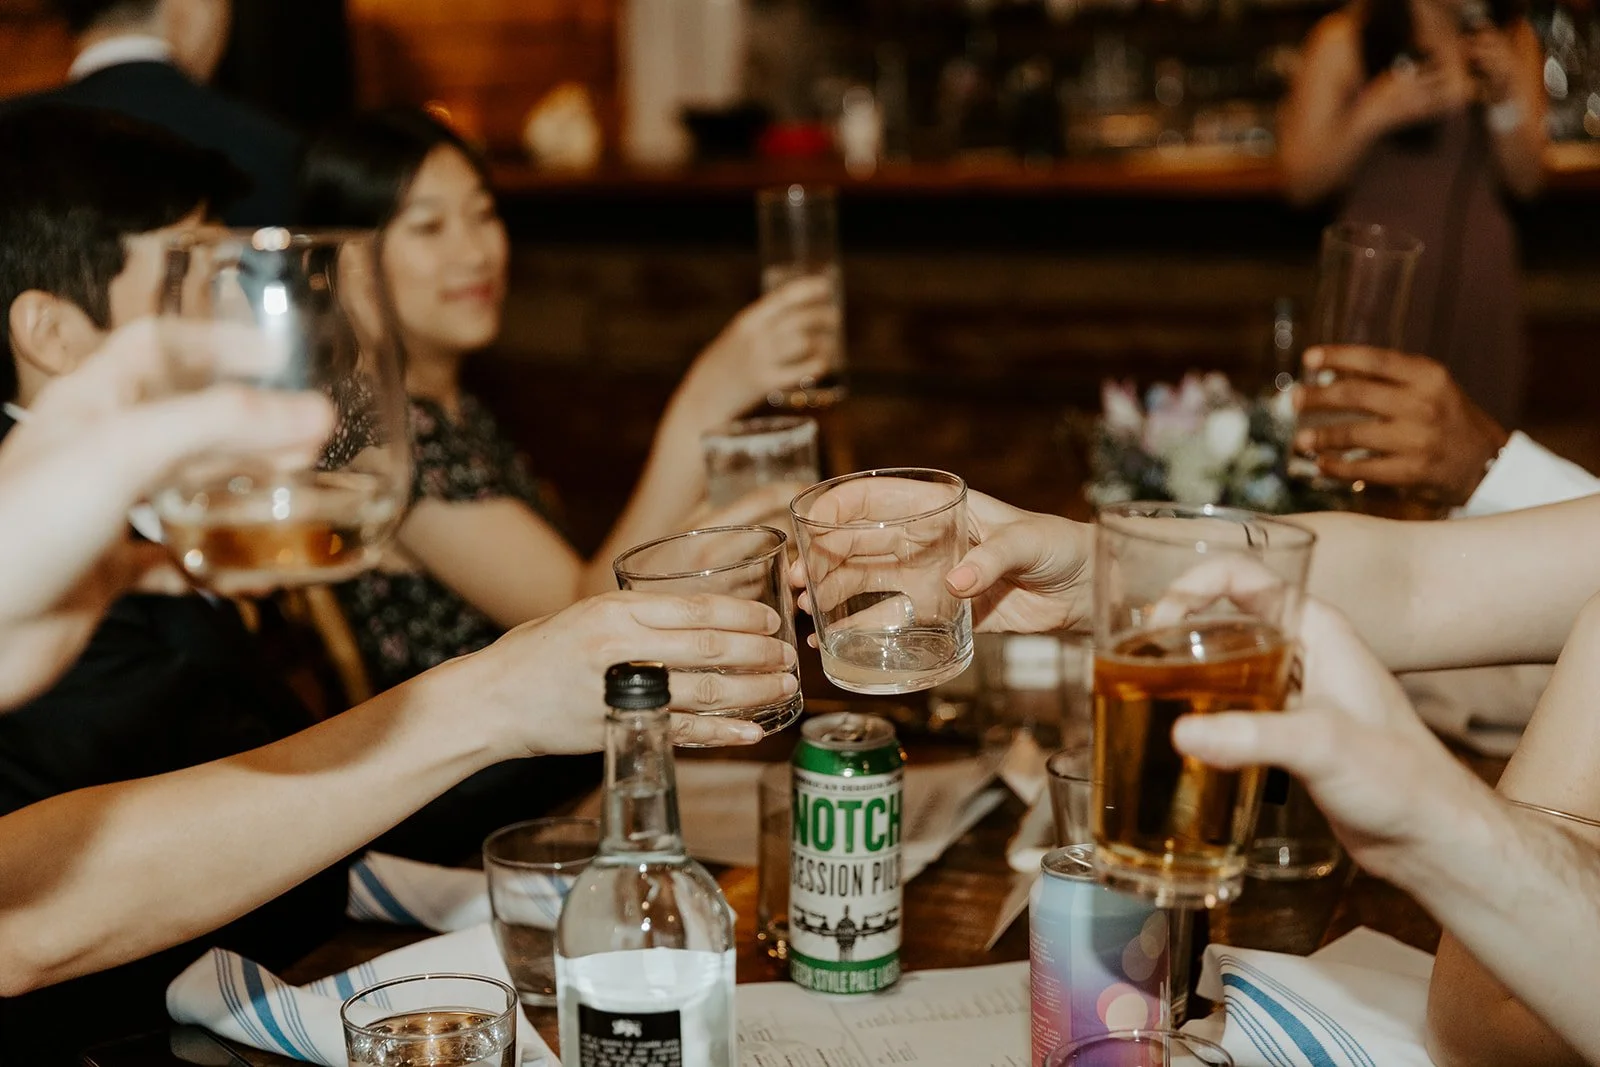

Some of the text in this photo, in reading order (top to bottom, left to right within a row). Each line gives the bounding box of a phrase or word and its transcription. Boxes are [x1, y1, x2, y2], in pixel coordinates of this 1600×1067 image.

[792, 787, 902, 853] NOTCH
[814, 966, 848, 993] STYLE
[849, 967, 876, 992] PALE
